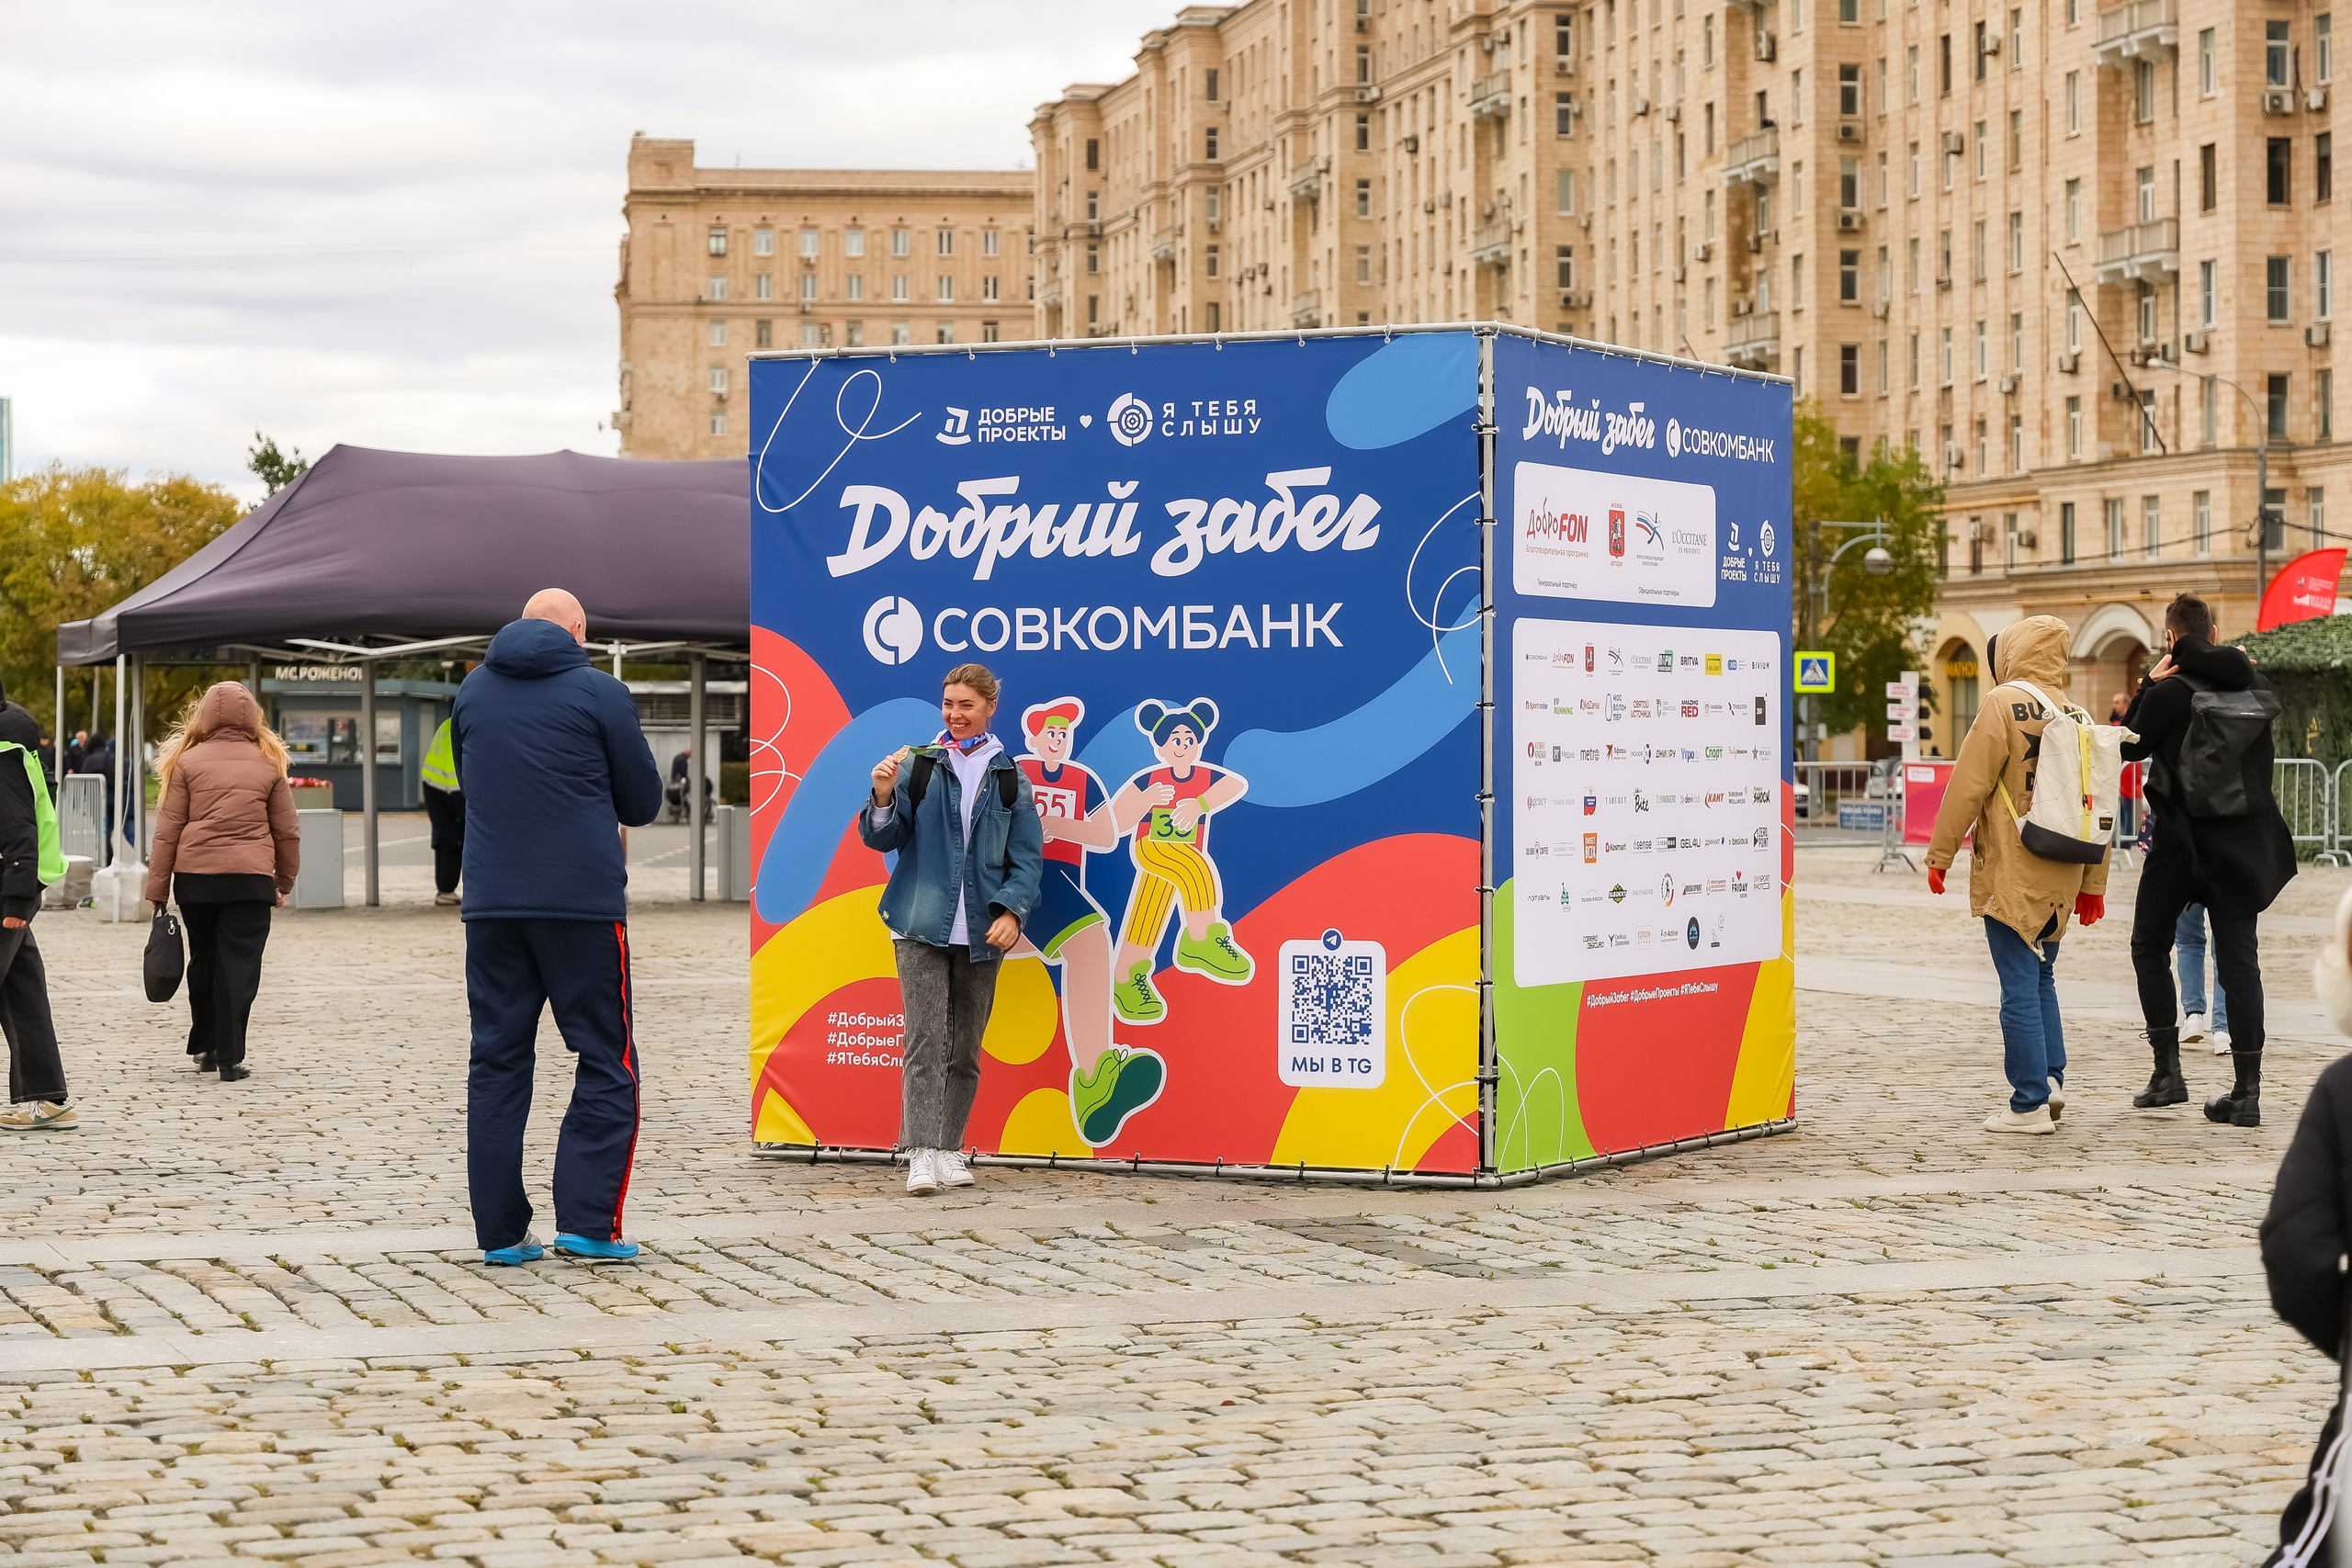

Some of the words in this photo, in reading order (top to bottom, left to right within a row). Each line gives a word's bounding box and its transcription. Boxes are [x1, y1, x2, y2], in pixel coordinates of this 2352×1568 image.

[978, 406, 1055, 426] ДОБРЫЕ
[1162, 402, 1175, 418] Я
[1192, 400, 1256, 417] ТЕБЯ
[1162, 418, 1261, 437] СЛЫШУ
[1522, 386, 1600, 449] Добрый
[1601, 401, 1656, 456] забег
[978, 425, 1067, 444] ПРОЕКТЫ
[1682, 427, 1775, 464] СОВКОМБАНК
[827, 475, 1141, 581] Добрый
[1151, 466, 1382, 577] забег
[1723, 557, 1745, 569] ДОБРЫЕ
[1755, 560, 1758, 570] Я
[1762, 561, 1780, 572] ТЕБЯ
[1721, 570, 1747, 581] ПРОЕКТЫ
[1754, 572, 1781, 584] СЛЫШУ
[933, 602, 1343, 653] СОВКОМБАНК
[1680, 657, 1699, 666] BRITVA
[277, 666, 363, 681] МОРОЖЕНО
[1681, 706, 1699, 717] RED
[1706, 746, 1724, 761] Спорт
[1634, 795, 1649, 813] Bite
[1708, 793, 1724, 803] КАНТ
[1680, 838, 1701, 849] GEL4U
[1585, 845, 1597, 859] BOX
[1732, 883, 1747, 893] FRIDAY
[1637, 931, 1651, 939] EDISON
[1587, 991, 1629, 1009] #ДобрыйЗабег
[1630, 987, 1679, 1003] #ДобрыеПроекты
[1680, 981, 1718, 995] #ЯТебяСлышу
[827, 1012, 904, 1029] #ДобрыйЗ
[1292, 1057, 1324, 1072] МЫ
[1332, 1057, 1342, 1073] В
[1348, 1058, 1372, 1074] TG
